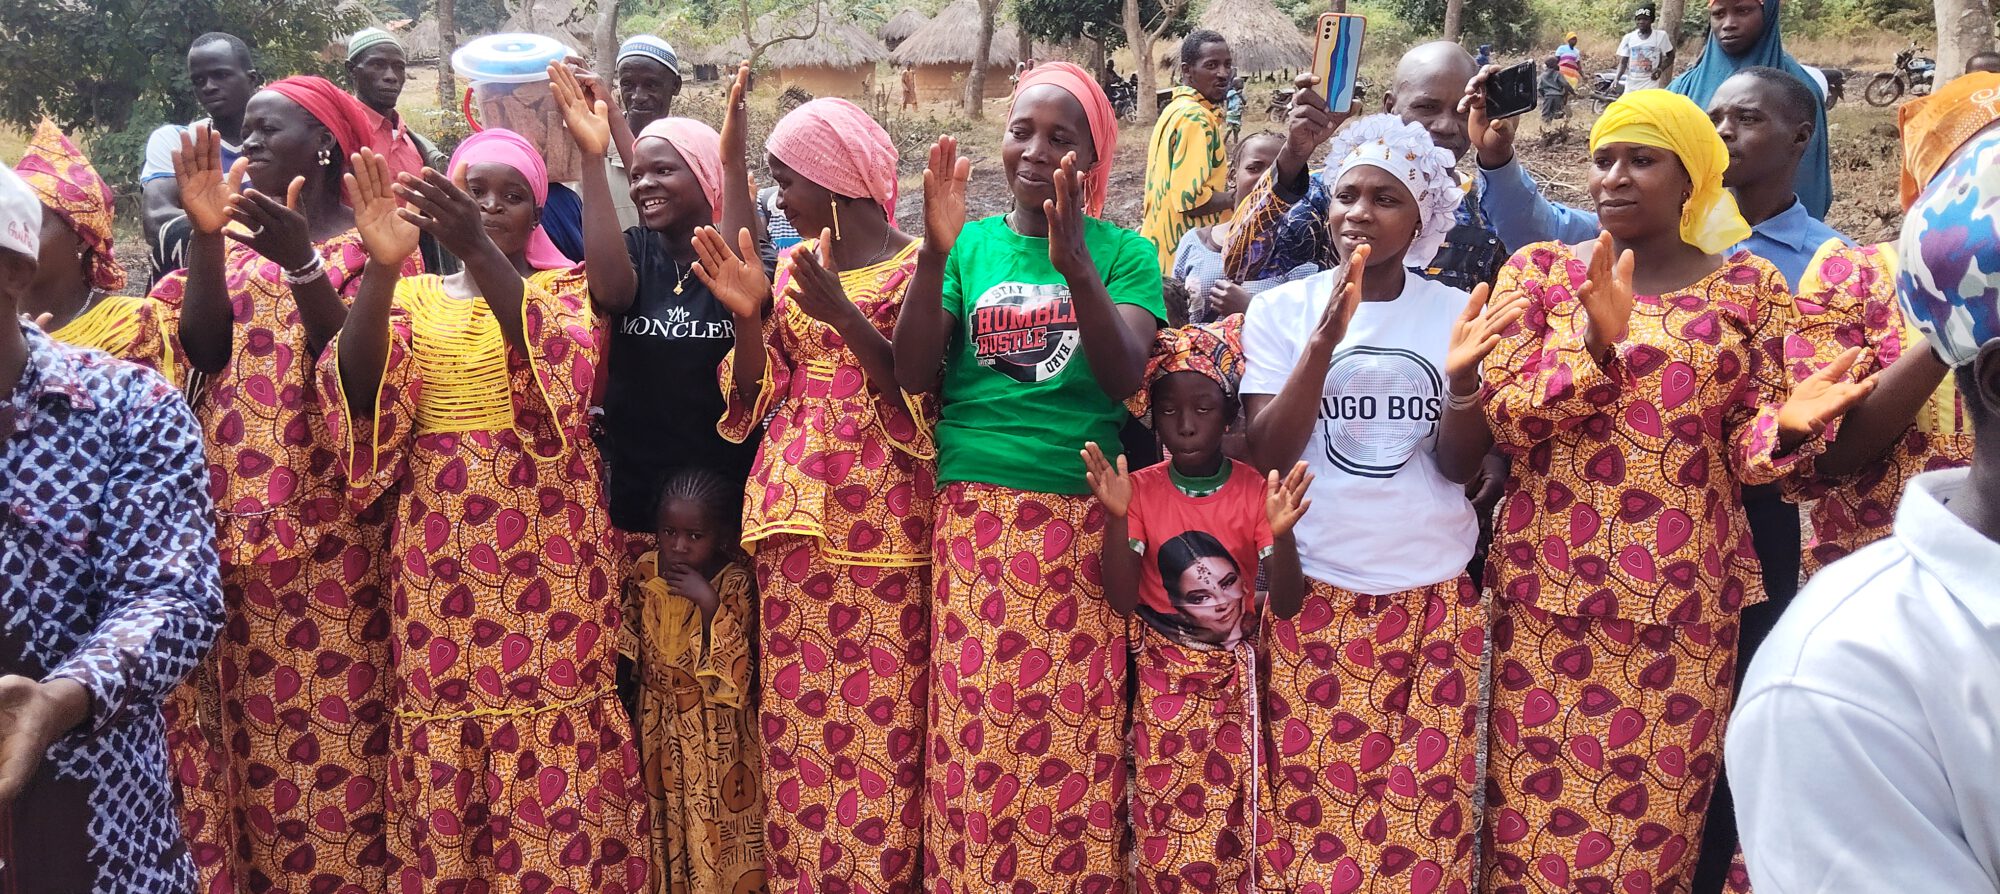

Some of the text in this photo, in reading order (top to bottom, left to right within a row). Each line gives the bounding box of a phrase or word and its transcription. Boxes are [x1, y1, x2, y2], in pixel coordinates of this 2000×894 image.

[991, 285, 1023, 299] STAY
[620, 316, 736, 338] MONCLER
[979, 328, 1046, 355] HUSTLE
[1045, 343, 1071, 374] HARD
[1318, 396, 1443, 421] UGO BOS
